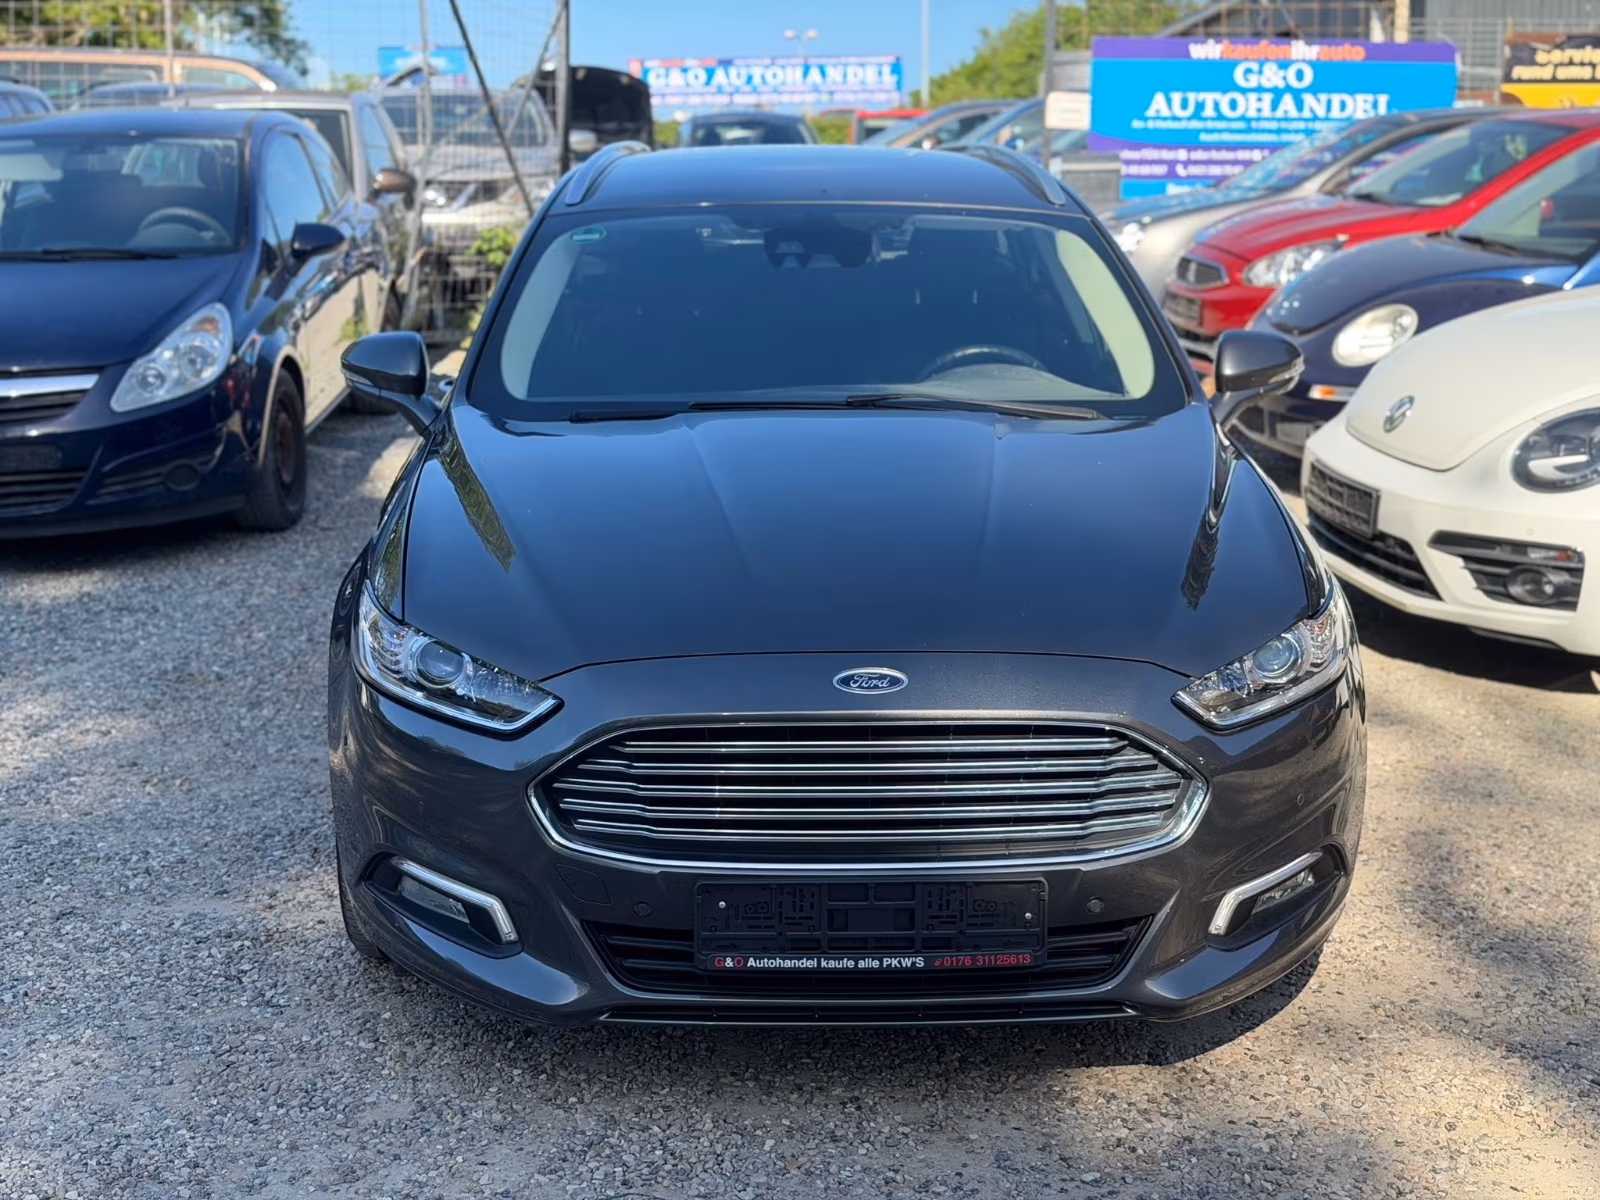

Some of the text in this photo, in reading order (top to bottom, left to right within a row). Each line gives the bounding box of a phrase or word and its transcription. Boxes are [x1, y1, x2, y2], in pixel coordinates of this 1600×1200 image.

[647, 62, 897, 87] G&O AUTOHANDEL
[1232, 62, 1314, 88] G&O
[849, 673, 891, 688] Ford
[714, 953, 1031, 969] G&O Autohandel kaufe alle PKW'S 0176 31125613
